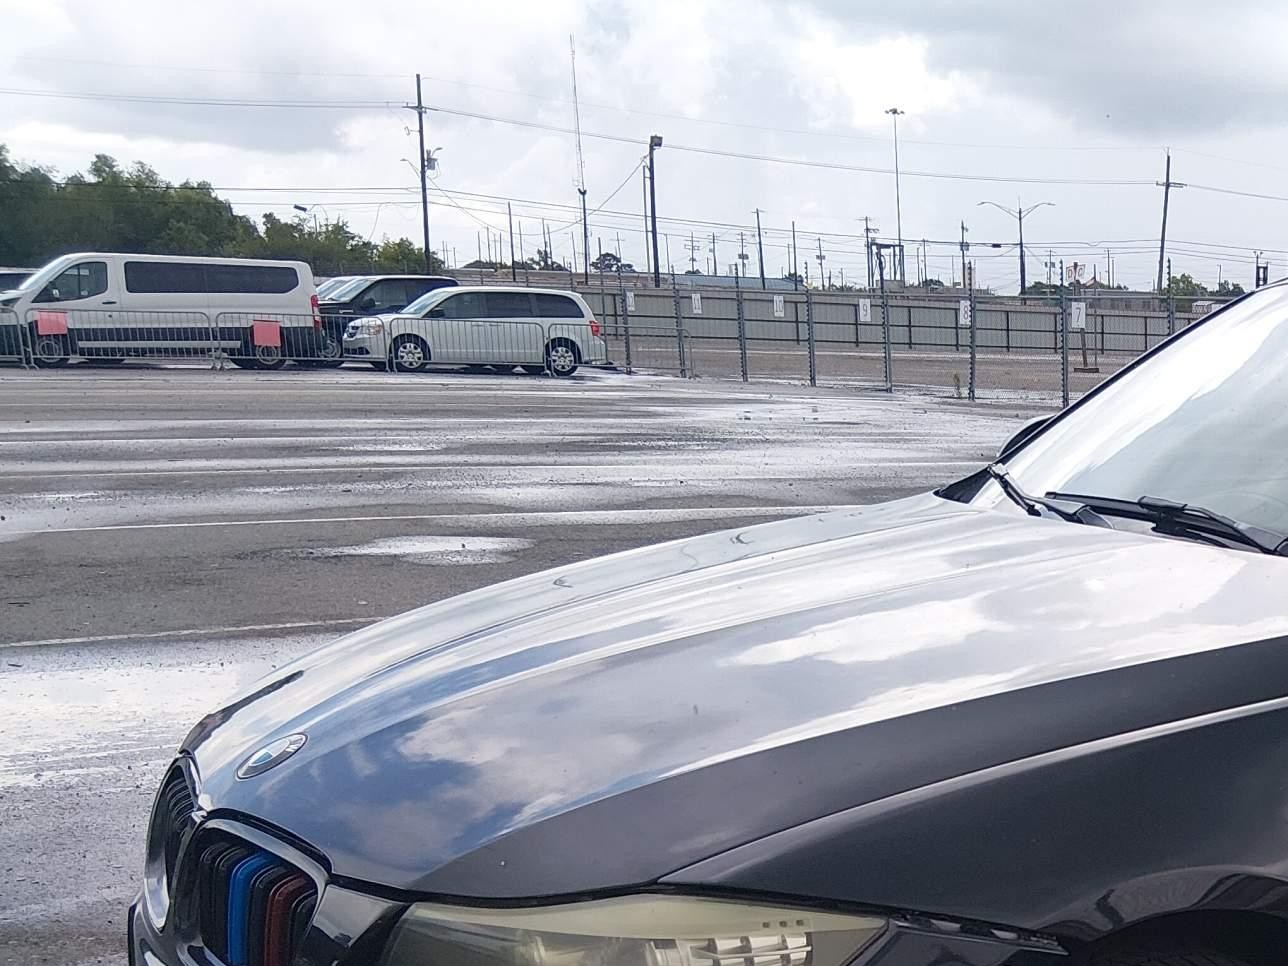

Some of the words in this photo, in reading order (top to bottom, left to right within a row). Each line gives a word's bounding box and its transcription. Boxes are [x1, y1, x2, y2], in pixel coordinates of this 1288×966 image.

[775, 299, 784, 313] 10
[862, 303, 868, 317] 9
[963, 305, 969, 320] 8
[1075, 307, 1082, 322] 7
